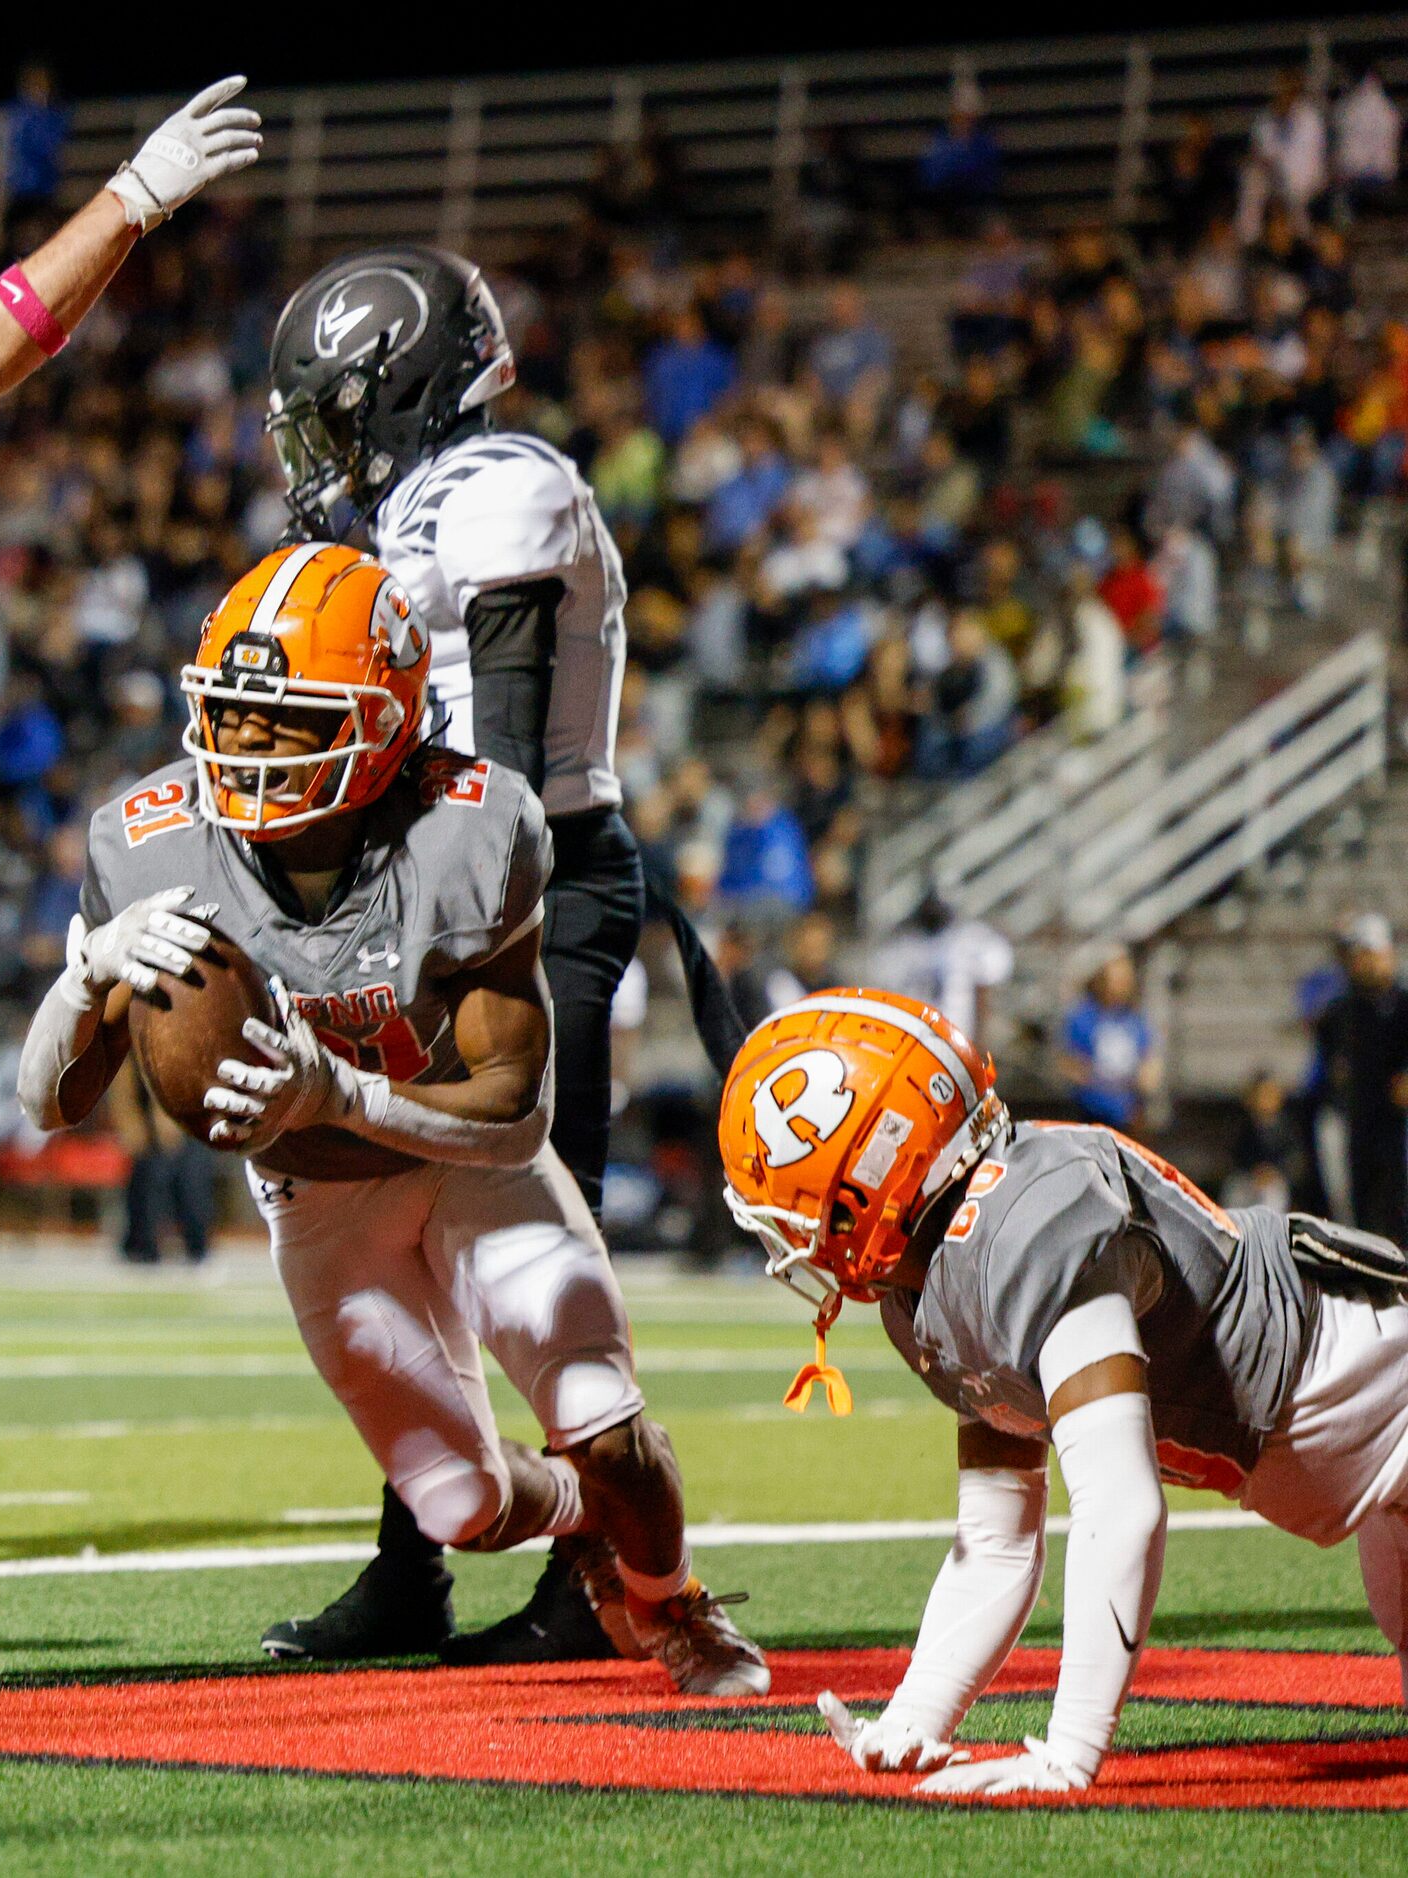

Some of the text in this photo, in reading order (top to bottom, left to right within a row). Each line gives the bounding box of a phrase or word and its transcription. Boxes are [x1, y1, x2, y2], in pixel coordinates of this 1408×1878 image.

[122, 779, 196, 850] 21
[751, 1048, 856, 1169] R
[932, 1074, 954, 1102] 21
